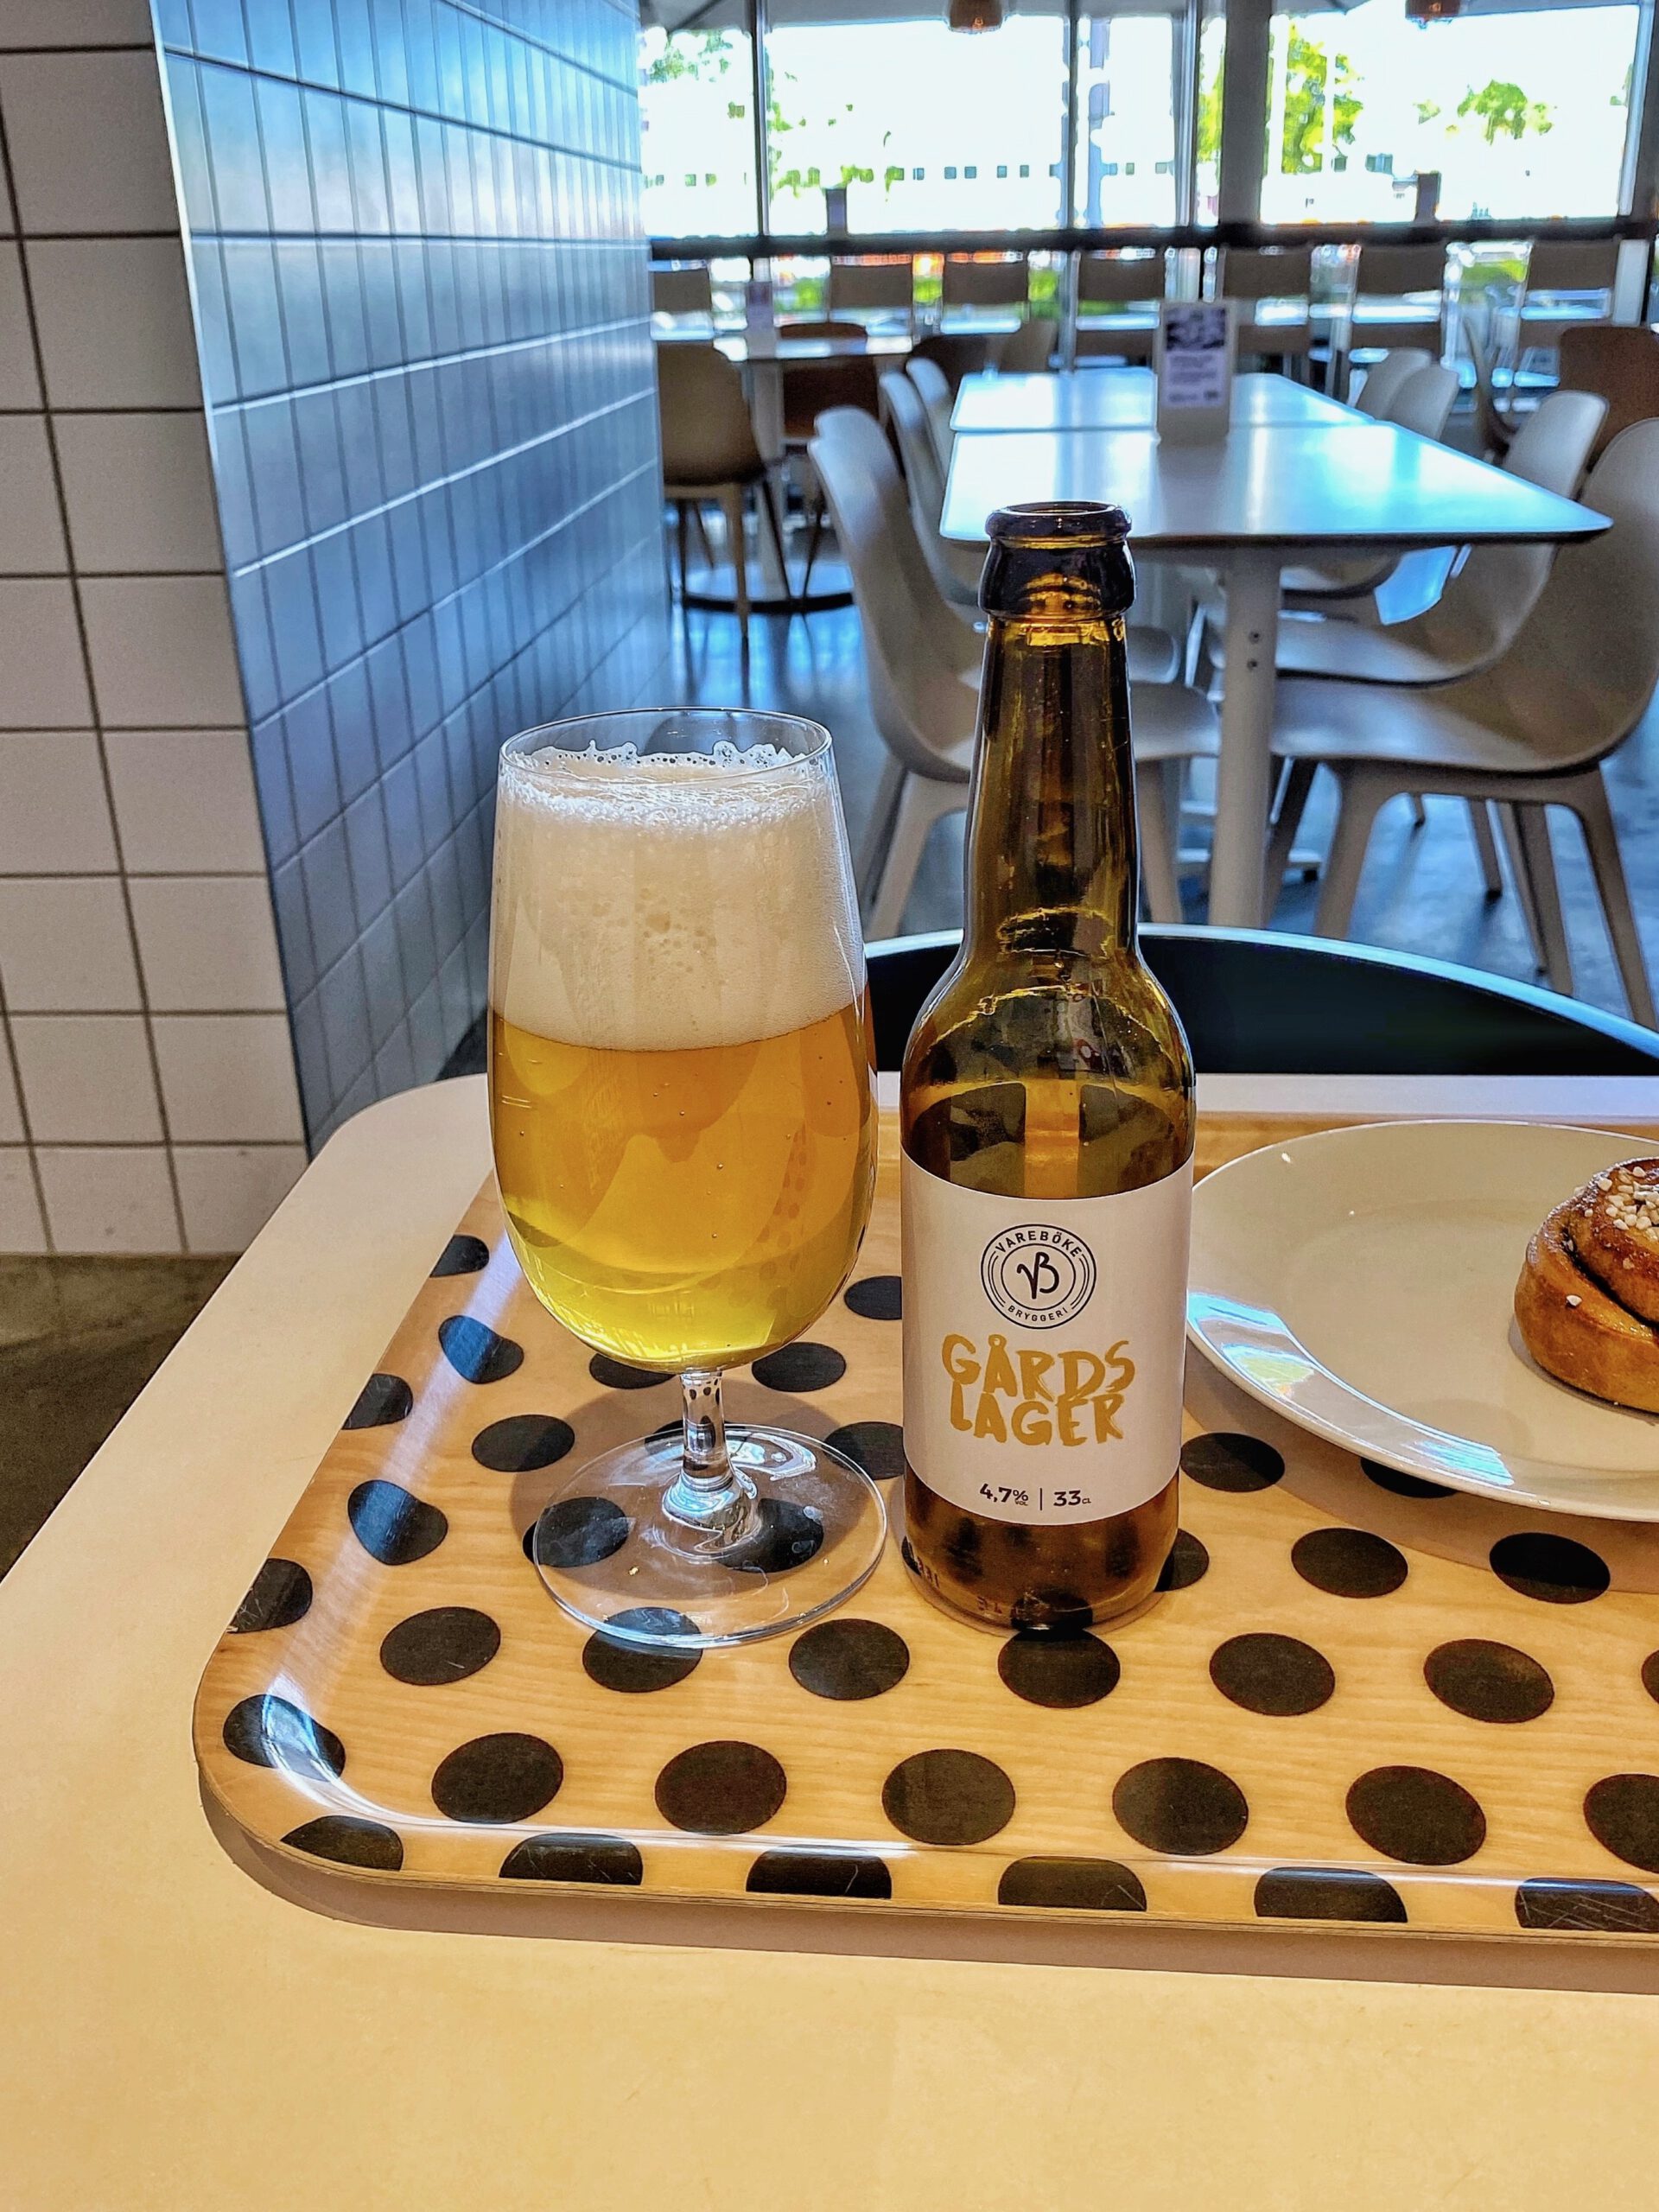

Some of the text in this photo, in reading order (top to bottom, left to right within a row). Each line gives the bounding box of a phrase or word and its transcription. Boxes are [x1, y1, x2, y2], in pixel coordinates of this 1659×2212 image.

[995, 1230, 1083, 1257] VAREBÖKE
[1007, 1305, 1068, 1322] BRYGGERI
[941, 1333, 1135, 1402] GÅRDS
[950, 1381, 1124, 1446] LAGER
[979, 1483, 1029, 1503] 4,7%
